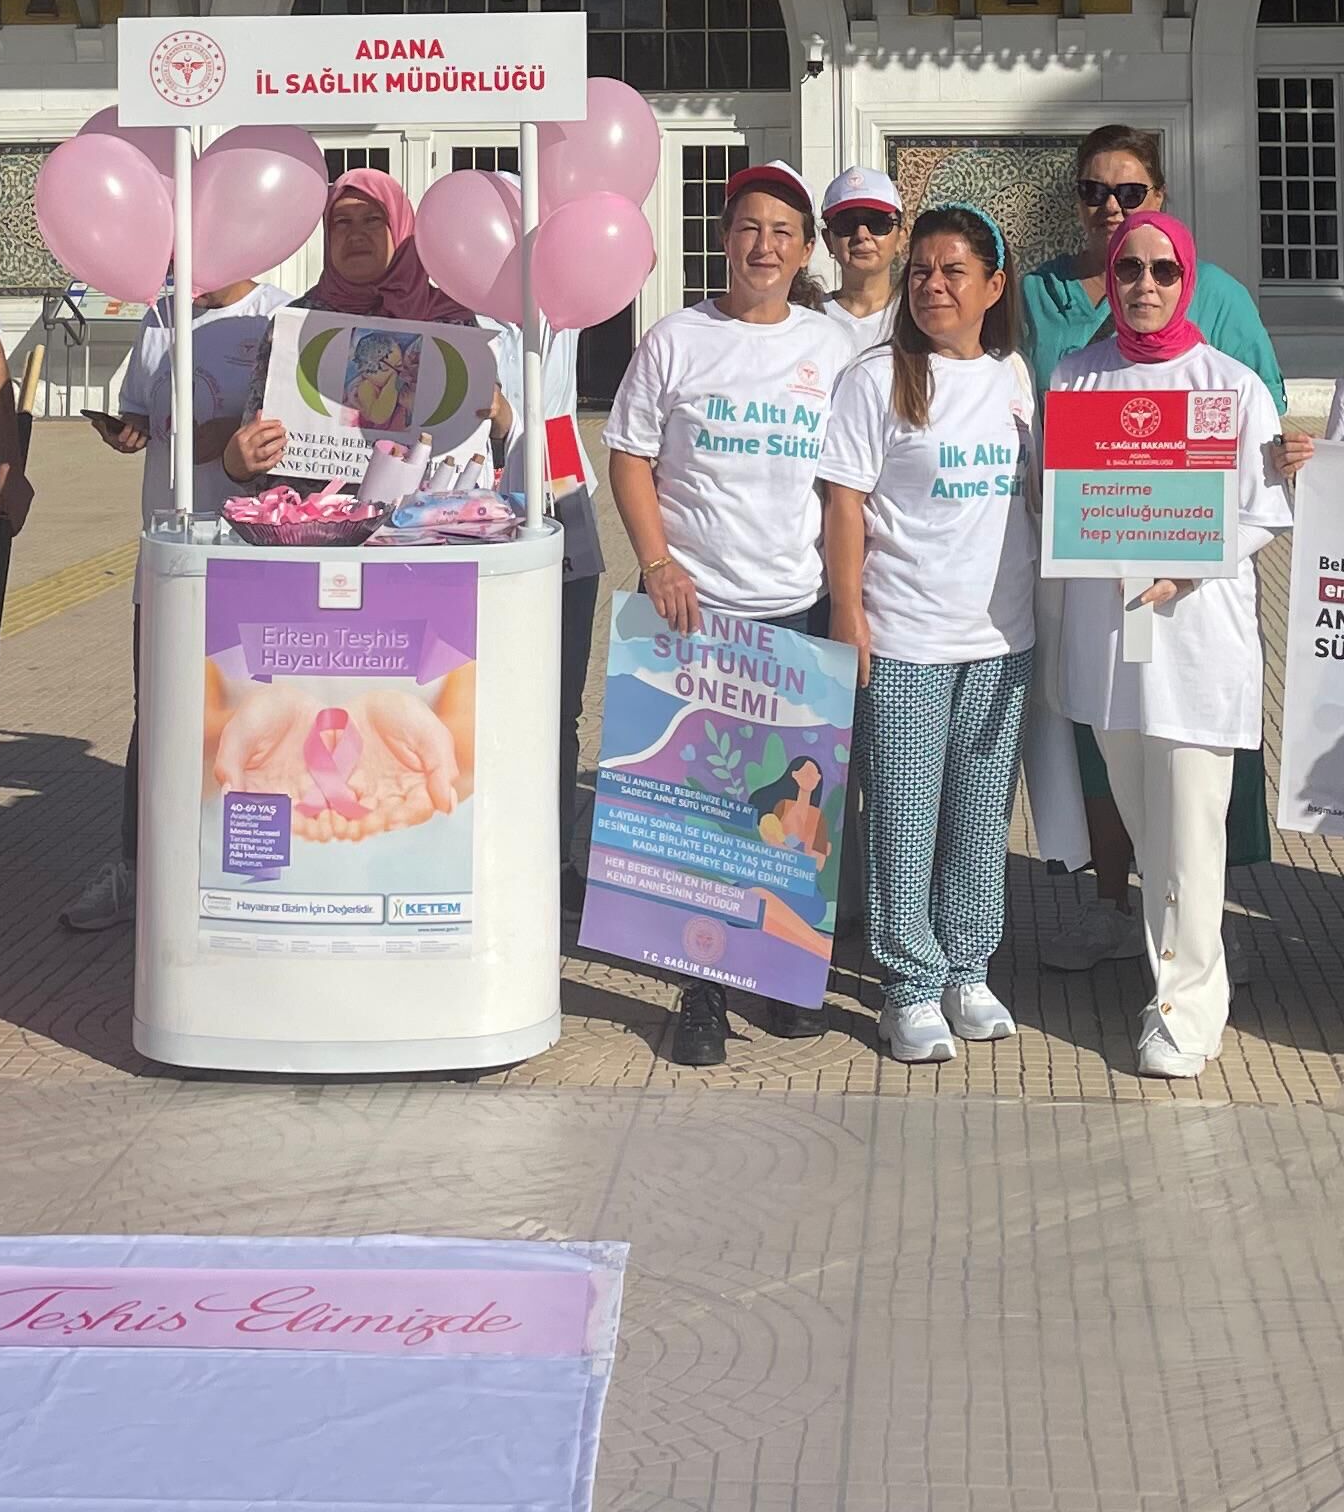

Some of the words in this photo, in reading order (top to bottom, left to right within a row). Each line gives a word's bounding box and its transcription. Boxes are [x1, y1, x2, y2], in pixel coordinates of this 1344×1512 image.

[355, 39, 445, 60] ADANA
[256, 69, 279, 94] İL
[285, 68, 379, 94] SAĞLIK
[386, 65, 545, 93] MÜDÜRLÜĞÜ
[743, 401, 786, 424] Altı
[792, 404, 822, 433] Ay
[288, 431, 339, 446] NNELER,
[695, 428, 761, 455] Anne
[766, 434, 821, 460] Sütü
[1111, 440, 1140, 450] SAĞLIK
[1141, 440, 1186, 450] BAKANLIĞI
[281, 445, 353, 462] ERECEĞİNİZ
[939, 441, 968, 468] İlk
[973, 443, 1011, 466] Altı
[279, 460, 302, 472] NNE
[304, 461, 363, 478] SÜTÜDÜR.
[930, 477, 989, 499] Anne
[994, 474, 1026, 497] Sü
[1081, 482, 1153, 496] Emzirme
[1080, 504, 1214, 522] yolculuğunuzda
[1080, 527, 1112, 544] hep
[261, 625, 329, 648] Erken
[333, 626, 410, 654] Teşhis
[261, 649, 324, 673] Hayat
[326, 651, 410, 670] Kurtarır.
[675, 665, 778, 722] ÖNEMİ
[600, 770, 632, 784] SEVGİLİ
[674, 786, 721, 806] BEBEĞİNİZE
[721, 798, 735, 810] İLK
[742, 806, 753, 814] AY
[620, 785, 652, 800] SADECE
[653, 793, 677, 806] ANNE
[678, 798, 699, 811] SÜTÜ
[230, 803, 256, 813] 40-69
[257, 805, 277, 816] YAŞ
[608, 808, 648, 825] 6.AYDAN
[649, 817, 682, 834] SONRA
[684, 824, 701, 837] İSE
[702, 827, 734, 846] UYGUN
[736, 839, 798, 864] TAMAMLAYICI
[597, 817, 657, 840] BESİNLERLE
[658, 832, 702, 851] BİRLİKTE
[703, 844, 717, 855] EN
[718, 848, 731, 860] AZ
[733, 851, 740, 861] 2
[741, 854, 759, 868] YAŞ
[760, 859, 775, 871] VE
[775, 862, 816, 882] ÖTESİNE
[632, 838, 665, 856] KADAR
[667, 847, 721, 870] EMZİRMEYE
[722, 862, 756, 878] DEVAM
[757, 871, 790, 888] EDİNİZ
[604, 855, 625, 869] HER
[627, 862, 661, 879] BEBEK
[662, 869, 684, 884] İÇİN
[684, 875, 699, 888] EN
[700, 879, 714, 891] İYİ
[714, 883, 745, 900] BESİN
[606, 870, 637, 886] KENDİ
[638, 878, 692, 901] ANNESİNİN
[695, 892, 741, 912] SÜTÜDÜR
[236, 900, 281, 913] Hayatınız
[309, 901, 326, 916] İçin
[406, 902, 462, 915] KETEM
[642, 950, 661, 963] T.C.
[663, 955, 701, 974] SAĞLIK
[702, 966, 758, 989] BAKANLIĞI
[193, 1284, 524, 1348] Elimizde
